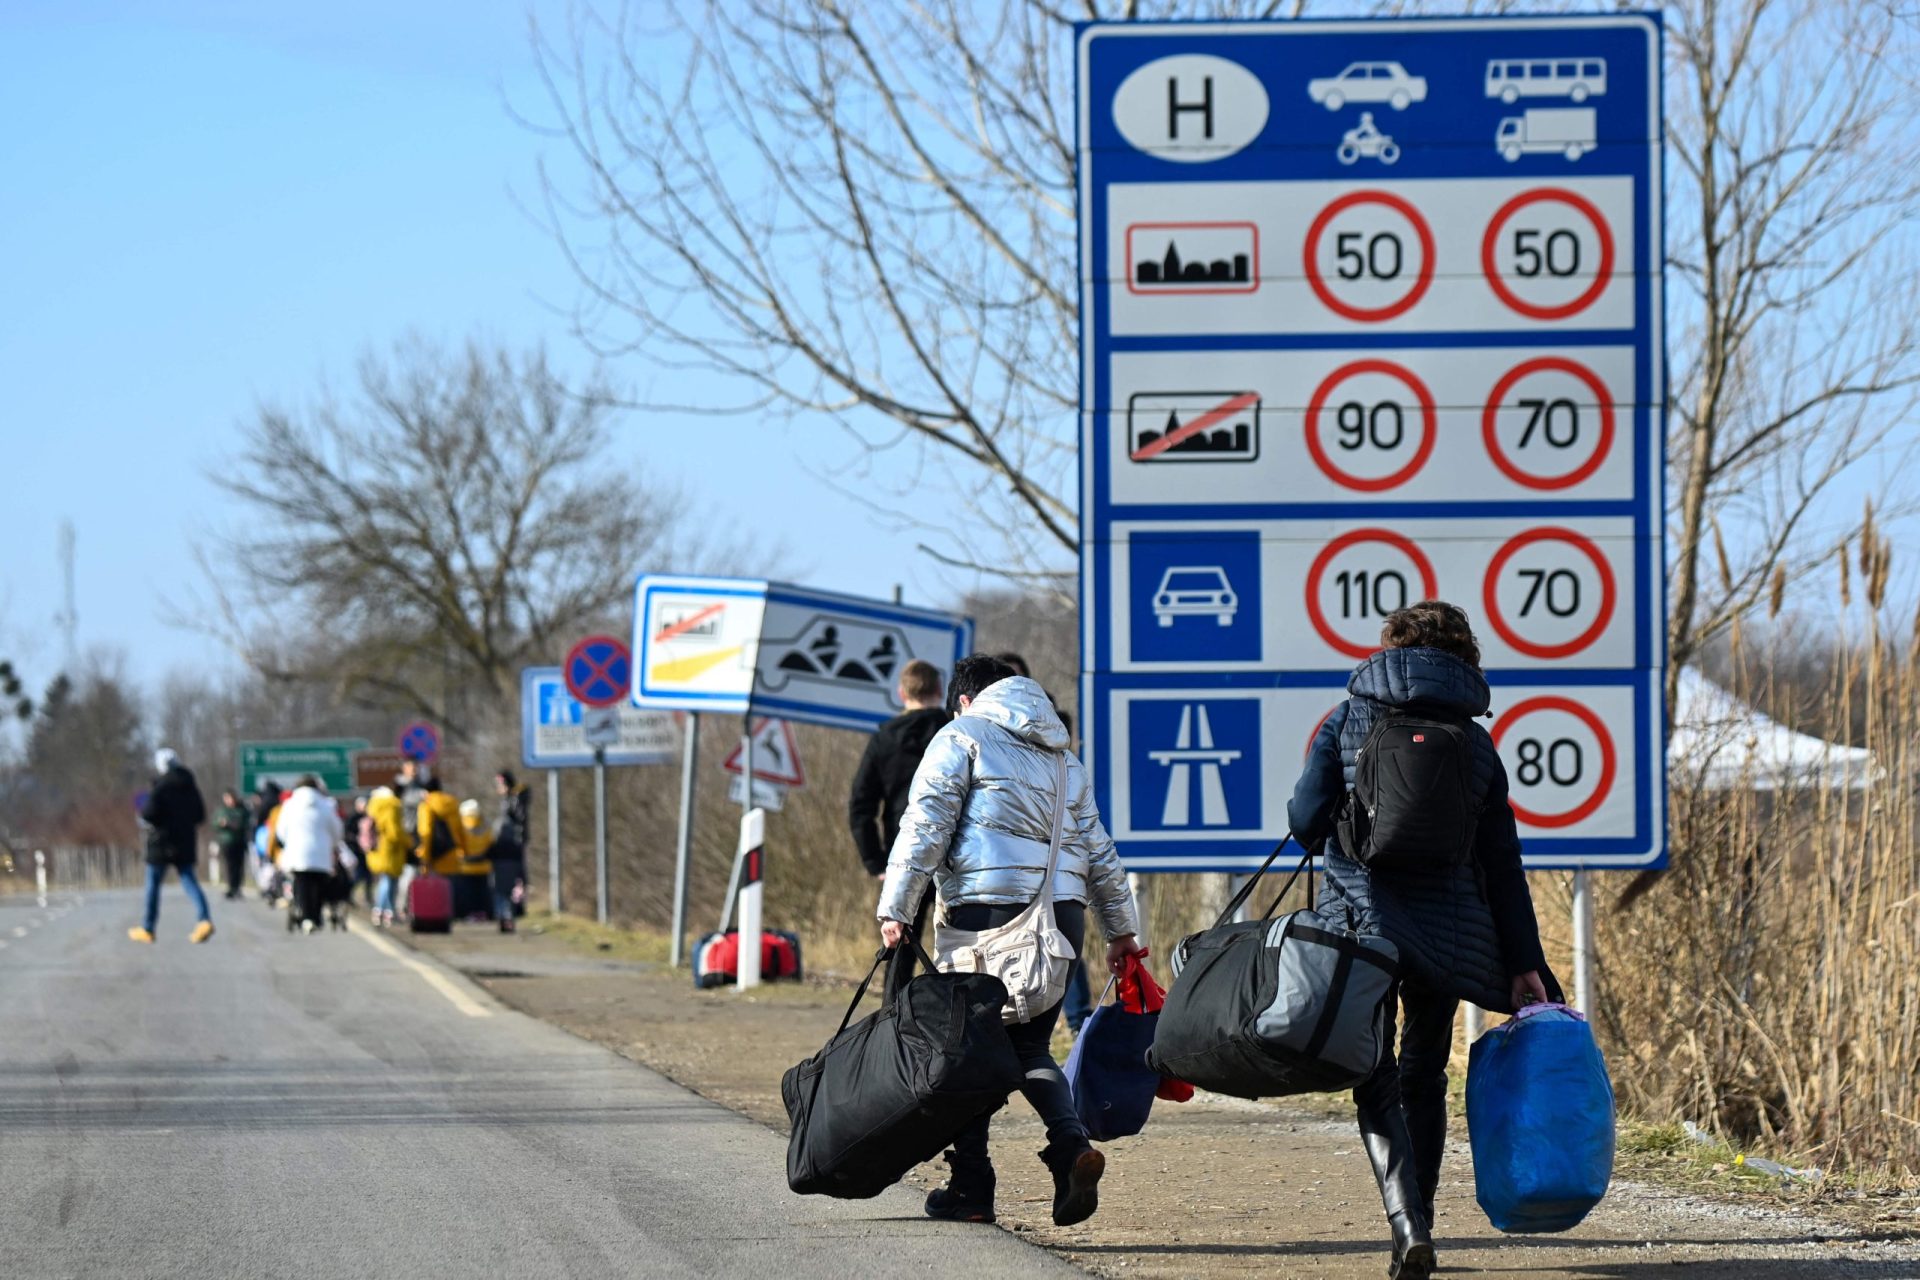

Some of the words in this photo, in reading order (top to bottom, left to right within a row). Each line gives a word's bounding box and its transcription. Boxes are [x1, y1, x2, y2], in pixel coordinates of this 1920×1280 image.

[1168, 76, 1214, 140] H
[1337, 232, 1403, 281] 50
[1514, 229, 1581, 279] 50
[1337, 400, 1404, 451] 90
[1516, 397, 1579, 449] 70
[1335, 570, 1407, 619] 110
[1517, 568, 1581, 618] 70
[1516, 737, 1583, 788] 80
